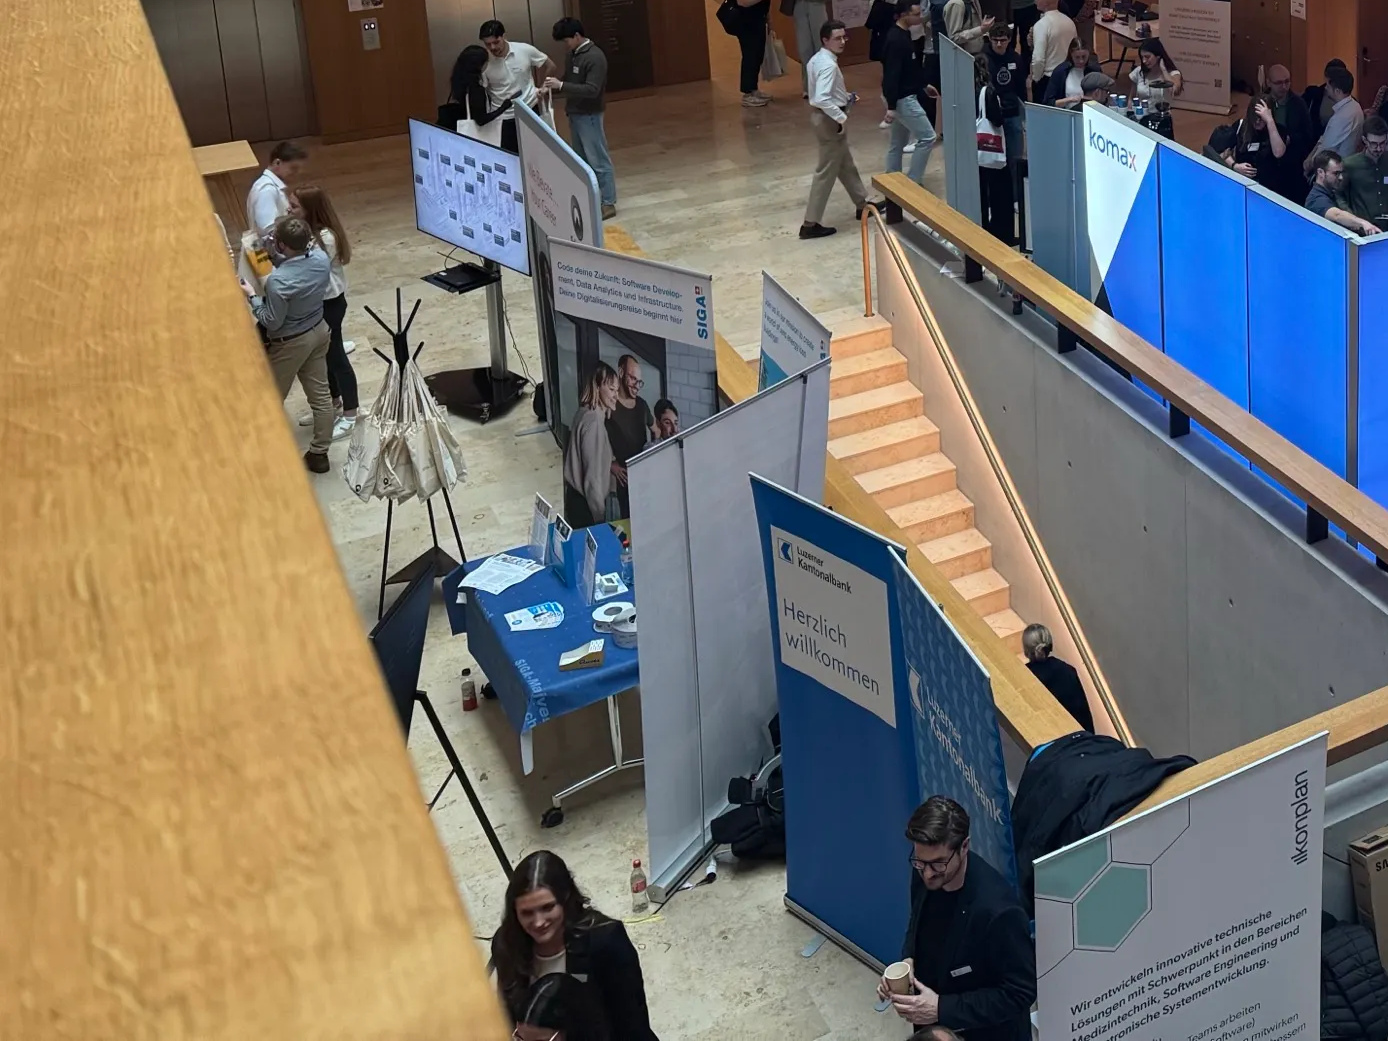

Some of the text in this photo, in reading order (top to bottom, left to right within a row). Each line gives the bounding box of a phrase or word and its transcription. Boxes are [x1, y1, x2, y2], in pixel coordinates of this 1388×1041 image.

[1089, 119, 1138, 172] komax
[557, 261, 574, 273] Code
[575, 267, 593, 278] deine
[621, 277, 651, 291] Software
[652, 284, 682, 299] Develop-
[559, 286, 576, 299] Deine
[577, 289, 642, 315] Digitalisierungsreise
[643, 306, 669, 322] beginnt
[576, 279, 592, 290] Data
[593, 283, 622, 298] Analytics
[623, 290, 636, 301] und
[695, 295, 709, 340] SIGA
[796, 545, 824, 568] Luzerner
[798, 556, 852, 594] Kantonalbank
[783, 598, 847, 649] Herzlich
[785, 631, 880, 696] willkommen
[925, 686, 962, 746] Luzerner
[928, 711, 1005, 825] Kantonalbank
[1070, 909, 1272, 1016] Wir entwickeln innovative technische
[1071, 907, 1308, 1032] Lösungen mit Schwerpunkt in den Bereichen
[1072, 925, 1300, 1041] Medizintechnik, Software Engineering und
[1162, 958, 1270, 1015] Systementwicklung.
[1220, 1002, 1261, 1029] arbeiten
[1252, 1012, 1299, 1041] mitwirken
